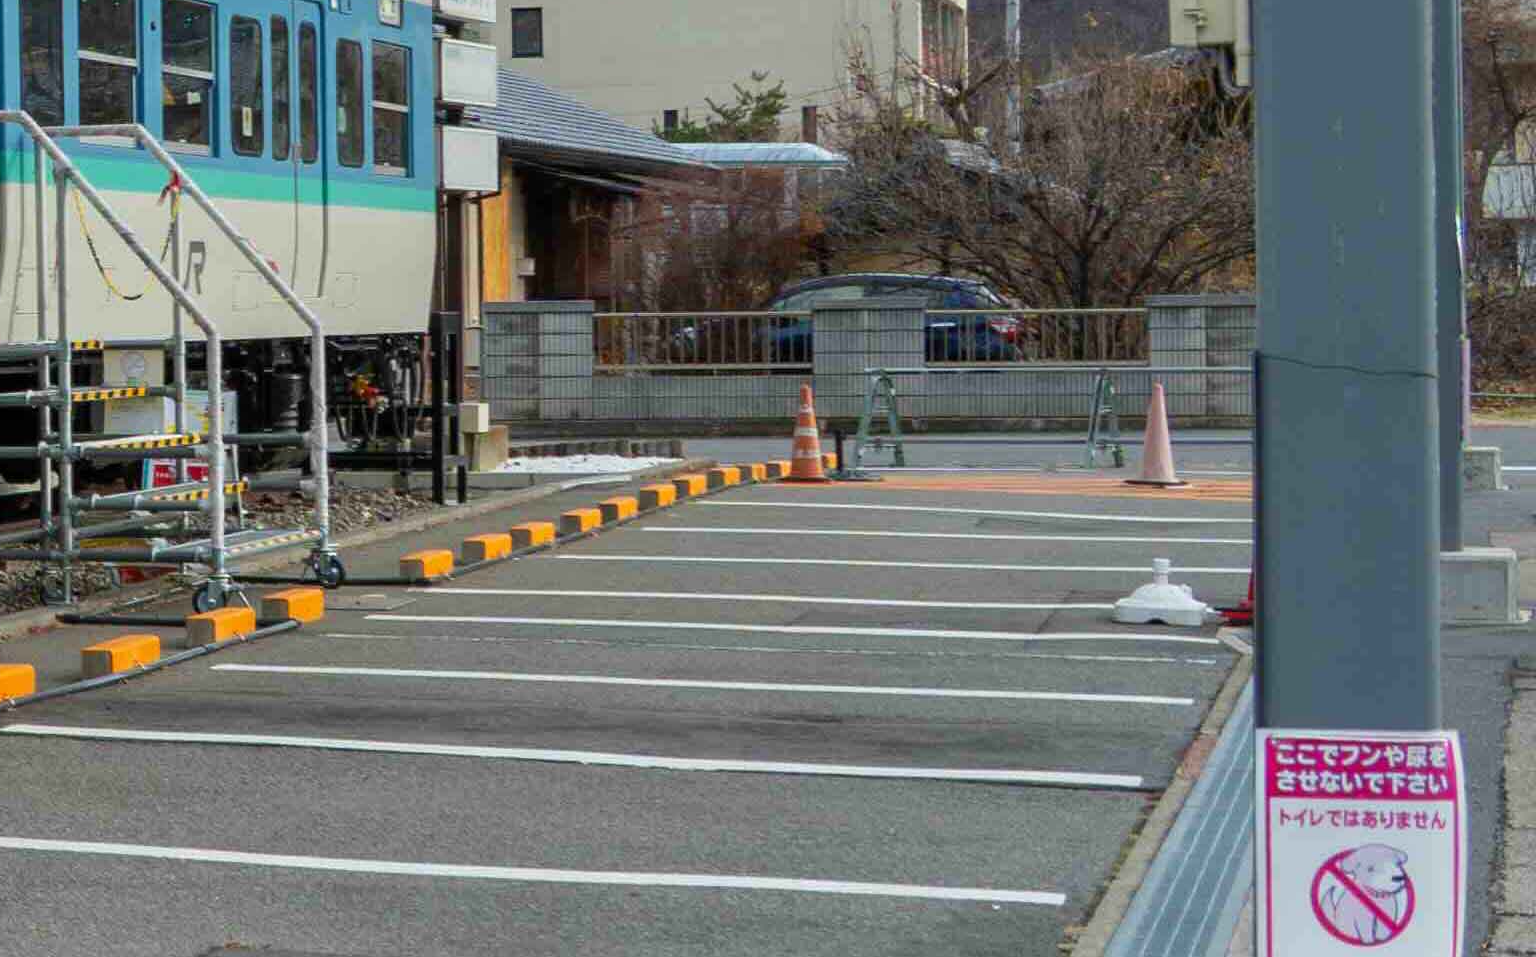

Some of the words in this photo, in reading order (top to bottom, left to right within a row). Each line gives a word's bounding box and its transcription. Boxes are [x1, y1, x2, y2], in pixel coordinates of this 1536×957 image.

[1276, 744, 1447, 768] ここでフンや尿を
[1276, 770, 1449, 795] させないで下さい
[1279, 807, 1447, 830] トイレではありません
